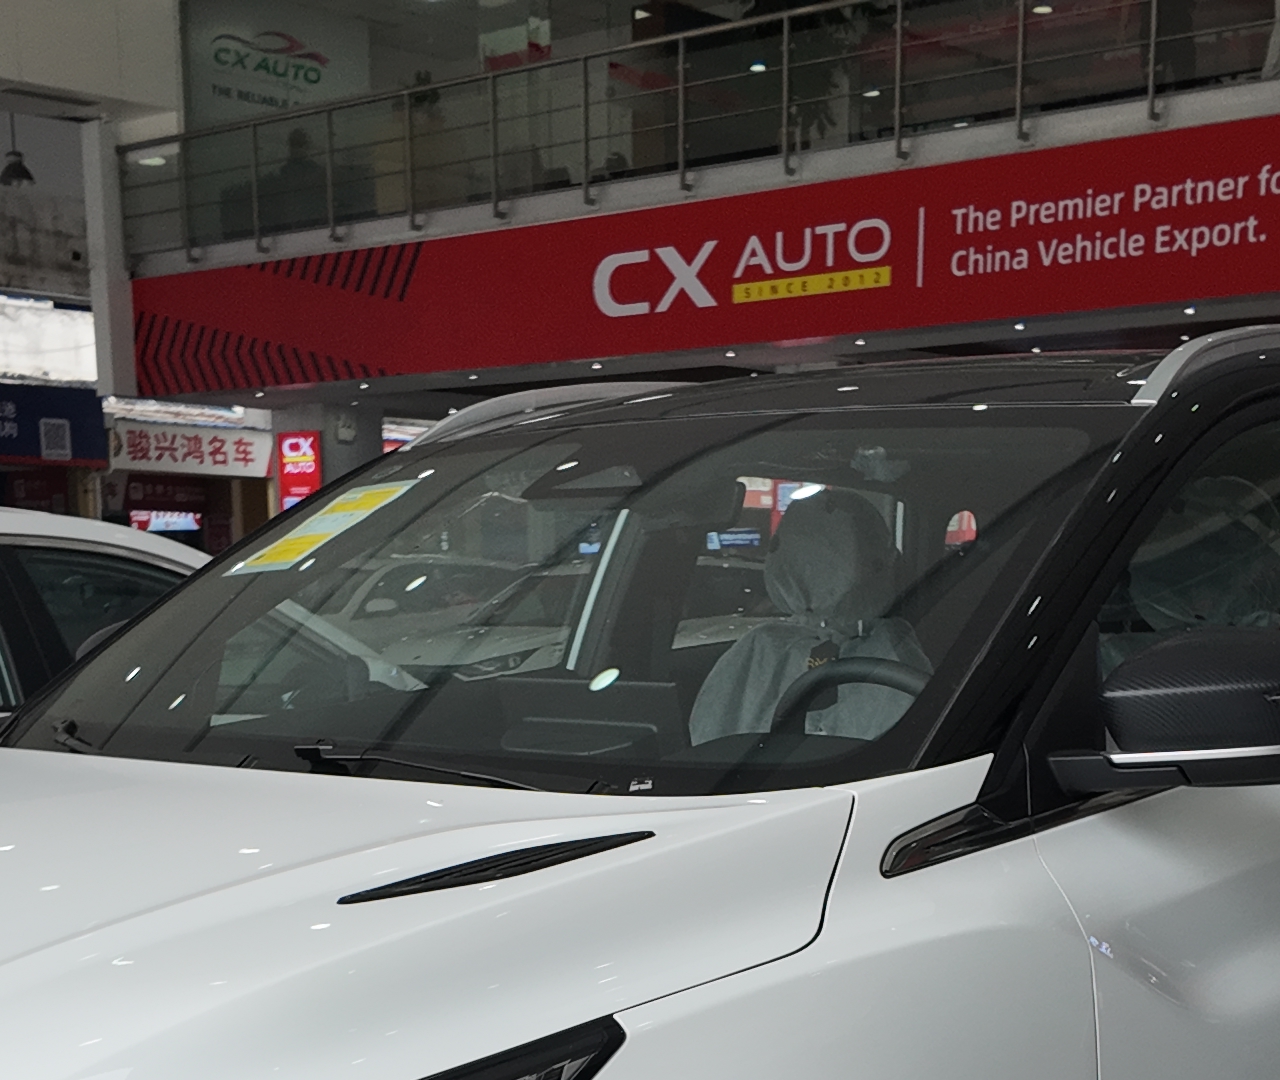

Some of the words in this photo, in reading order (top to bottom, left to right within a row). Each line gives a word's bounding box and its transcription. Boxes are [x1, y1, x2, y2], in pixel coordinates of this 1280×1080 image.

[213, 47, 249, 71] CX
[253, 58, 321, 85] AUTO
[951, 205, 1002, 235] The
[1010, 189, 1125, 229] Premier
[1133, 175, 1250, 213] Partner
[950, 244, 1029, 277] China
[1037, 227, 1146, 267] Vehicle
[1154, 214, 1268, 257] Export.
[592, 240, 719, 318] CX
[732, 218, 892, 279] AUTO
[743, 280, 809, 300] SINCE
[827, 271, 882, 290] 2012
[126, 429, 256, 468] 骏兴鸿名车
[282, 436, 315, 457] CX
